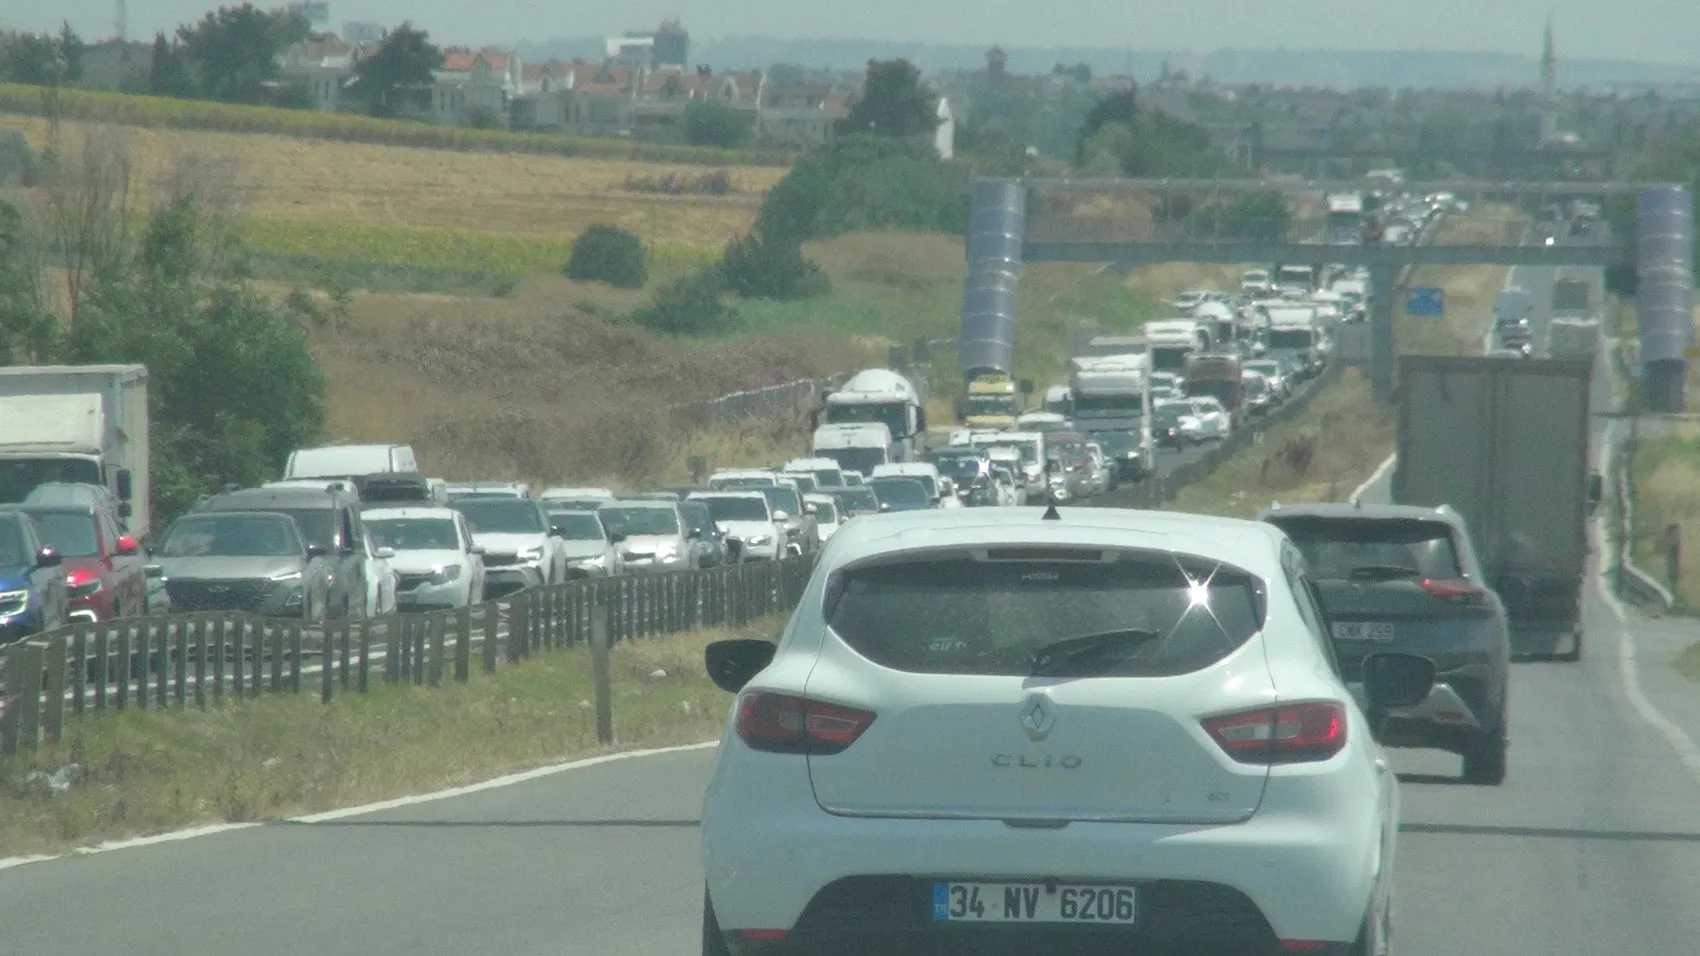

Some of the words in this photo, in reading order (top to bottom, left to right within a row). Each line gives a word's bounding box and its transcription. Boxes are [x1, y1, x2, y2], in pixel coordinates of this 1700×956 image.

[991, 753, 1082, 770] CLIO
[950, 885, 985, 918] 34
[1004, 886, 1039, 919] NV
[1061, 888, 1133, 921] 6206
